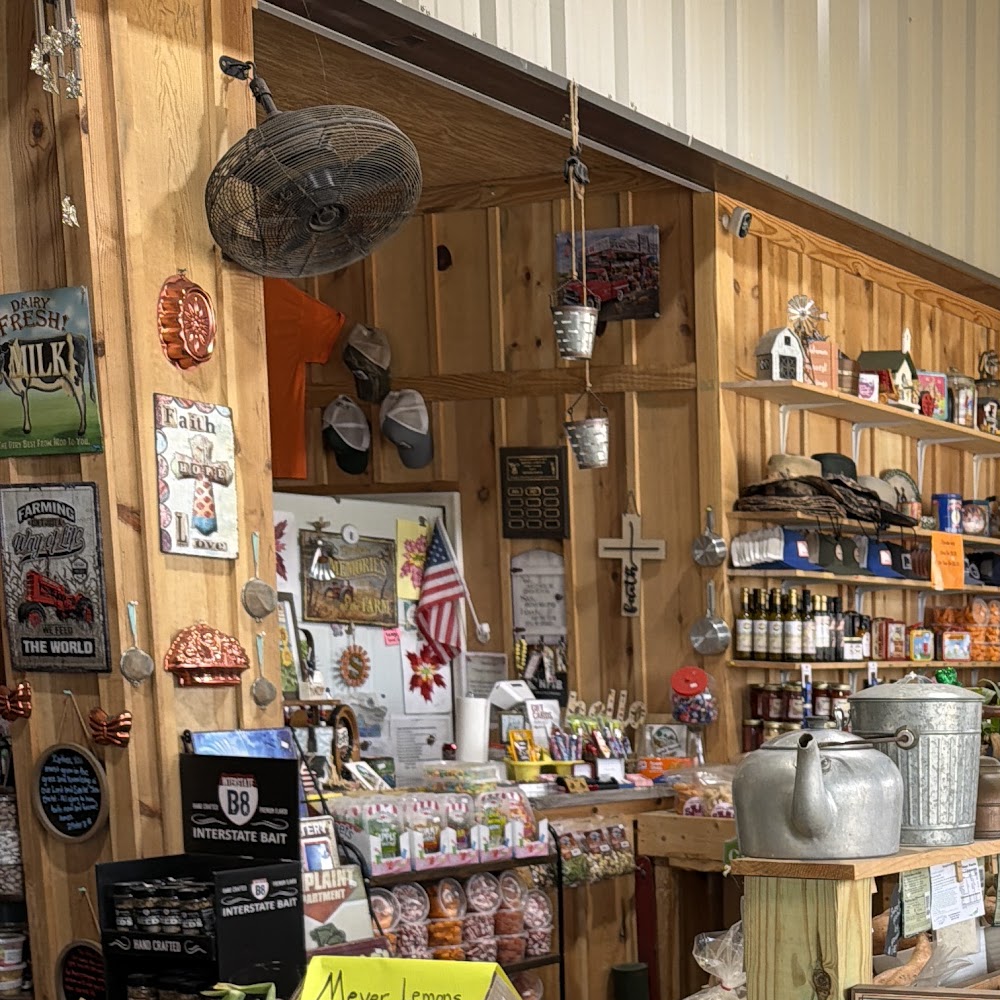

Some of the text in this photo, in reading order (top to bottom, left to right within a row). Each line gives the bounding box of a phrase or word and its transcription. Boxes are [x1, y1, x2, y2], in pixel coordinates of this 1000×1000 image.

[11, 297, 51, 312] DAIRY
[0, 309, 69, 337] FRESH!
[8, 341, 69, 379] MILK
[163, 405, 217, 436] Faith
[178, 460, 228, 481] HOPE
[17, 500, 76, 523] FARMING
[13, 527, 44, 557] Way
[61, 522, 85, 551] Life
[175, 511, 229, 553] Love
[329, 556, 387, 577] MEMORIES
[55, 625, 74, 635] FEED
[23, 639, 94, 655] THE WORLD
[565, 689, 648, 730] hello
[226, 789, 251, 817] B8
[192, 826, 288, 845] INTERSTATE BAIT
[222, 896, 298, 918] INTERSTATE BAIT
[133, 939, 182, 953] HAND CRAFTED
